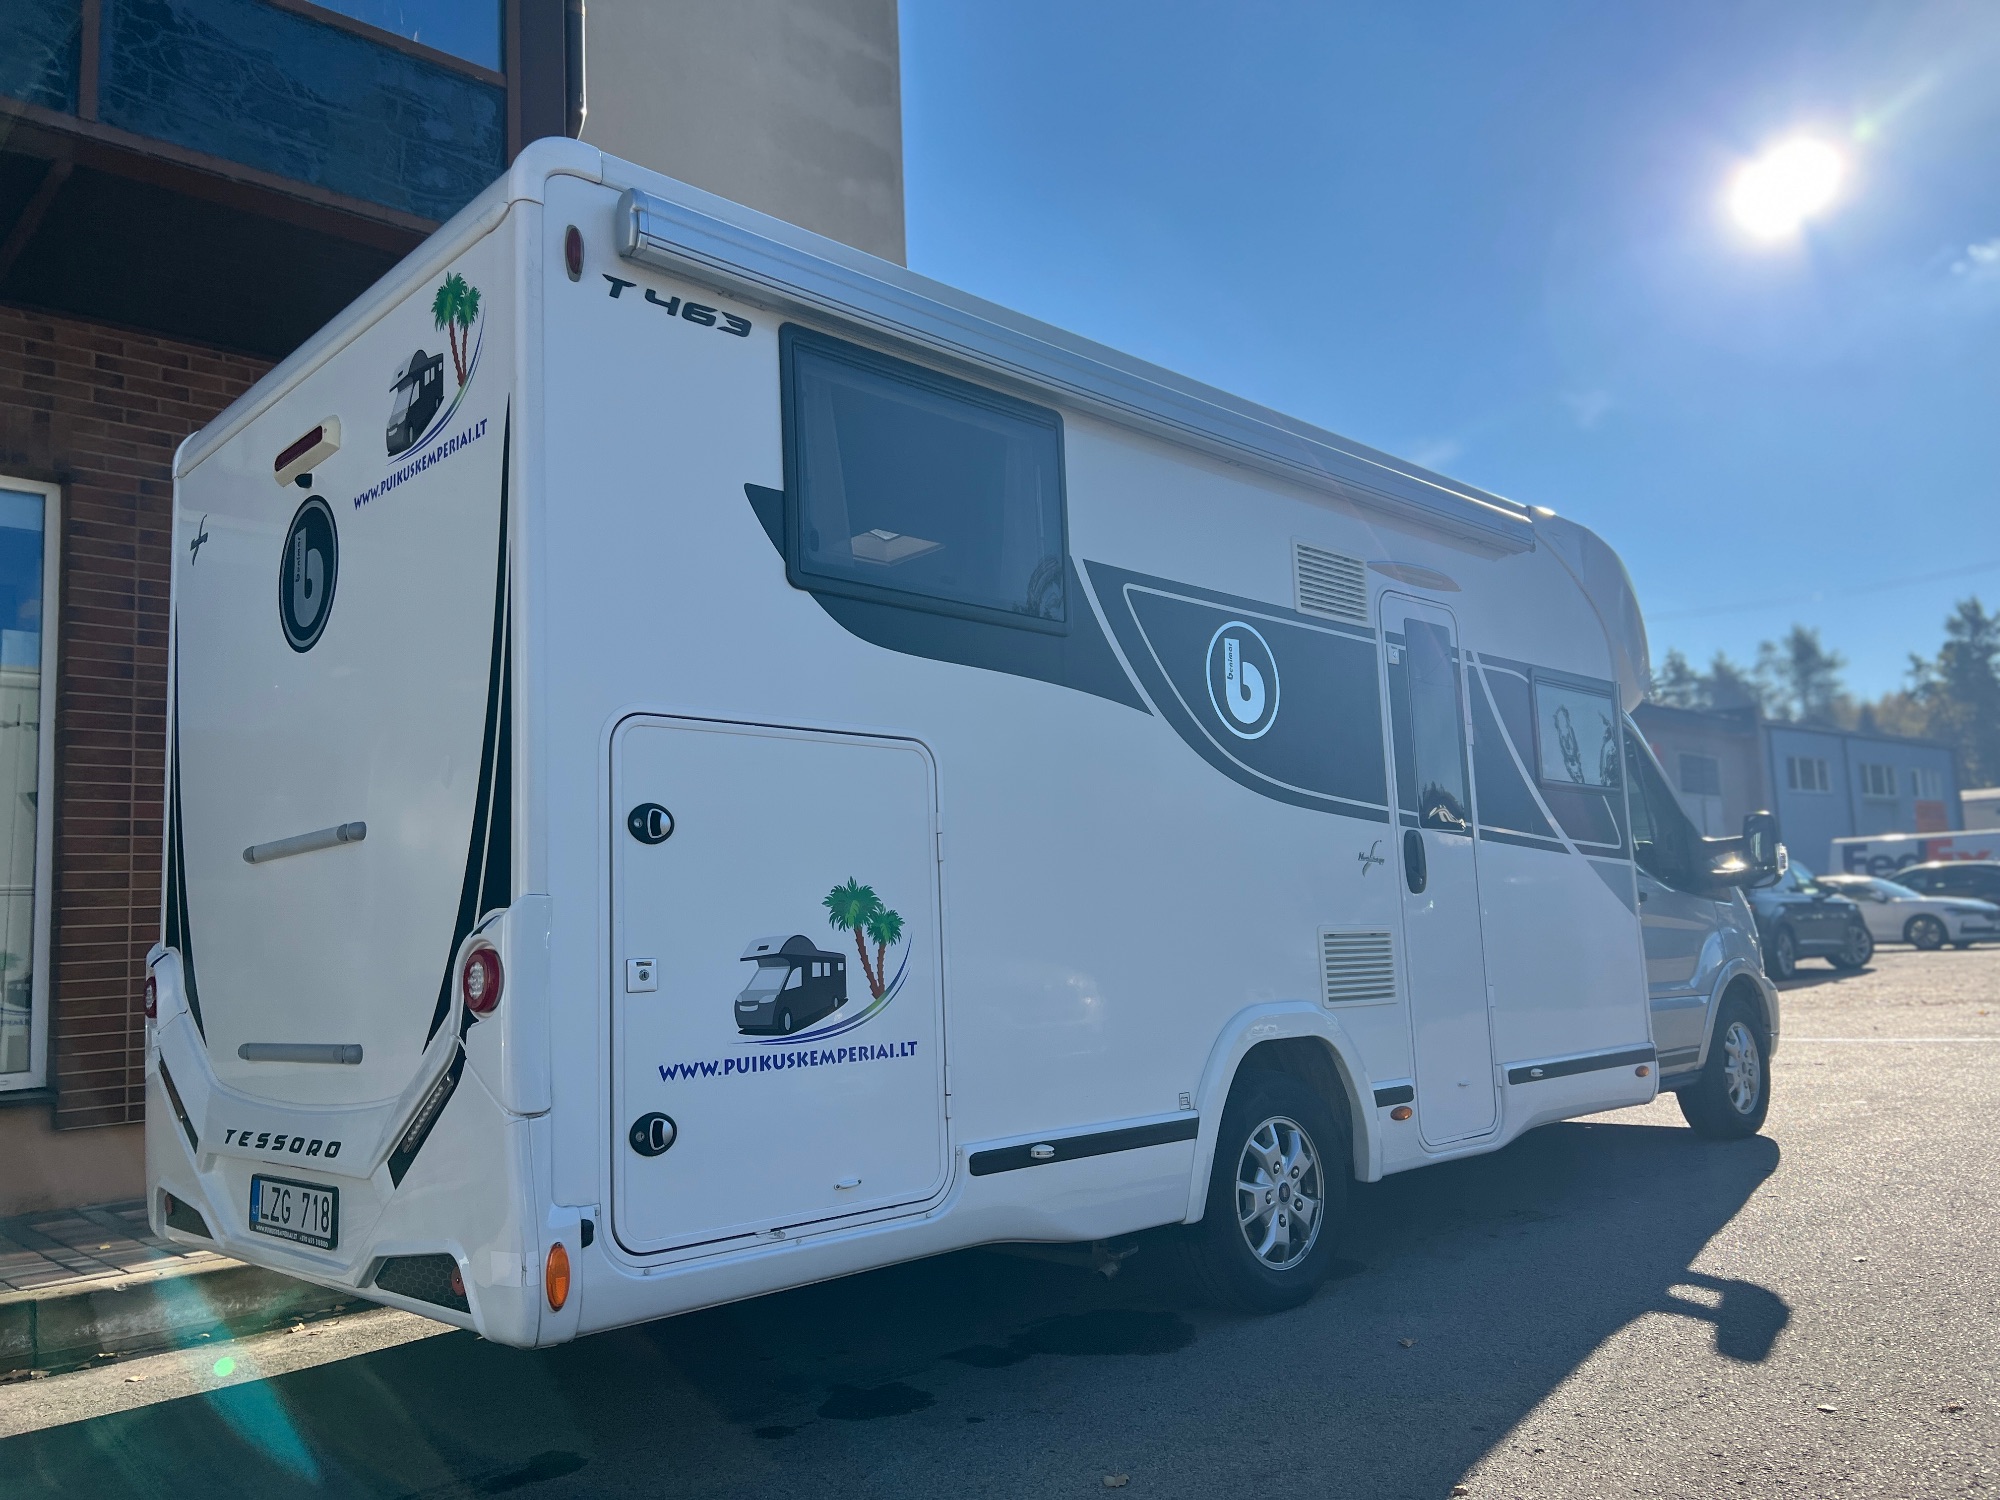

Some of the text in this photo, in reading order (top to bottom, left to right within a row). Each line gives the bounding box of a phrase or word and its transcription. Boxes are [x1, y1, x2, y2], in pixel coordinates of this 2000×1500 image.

[602, 273, 752, 338] T 463
[353, 418, 488, 511] WWW.PUIKUSKEMPERIAI.LT
[1226, 642, 1234, 681] benimar
[658, 1041, 918, 1083] WWW.PUIKUSKEMPERIAI.LT
[224, 1129, 342, 1158] TESSORO
[260, 1184, 330, 1233] LZG 718
